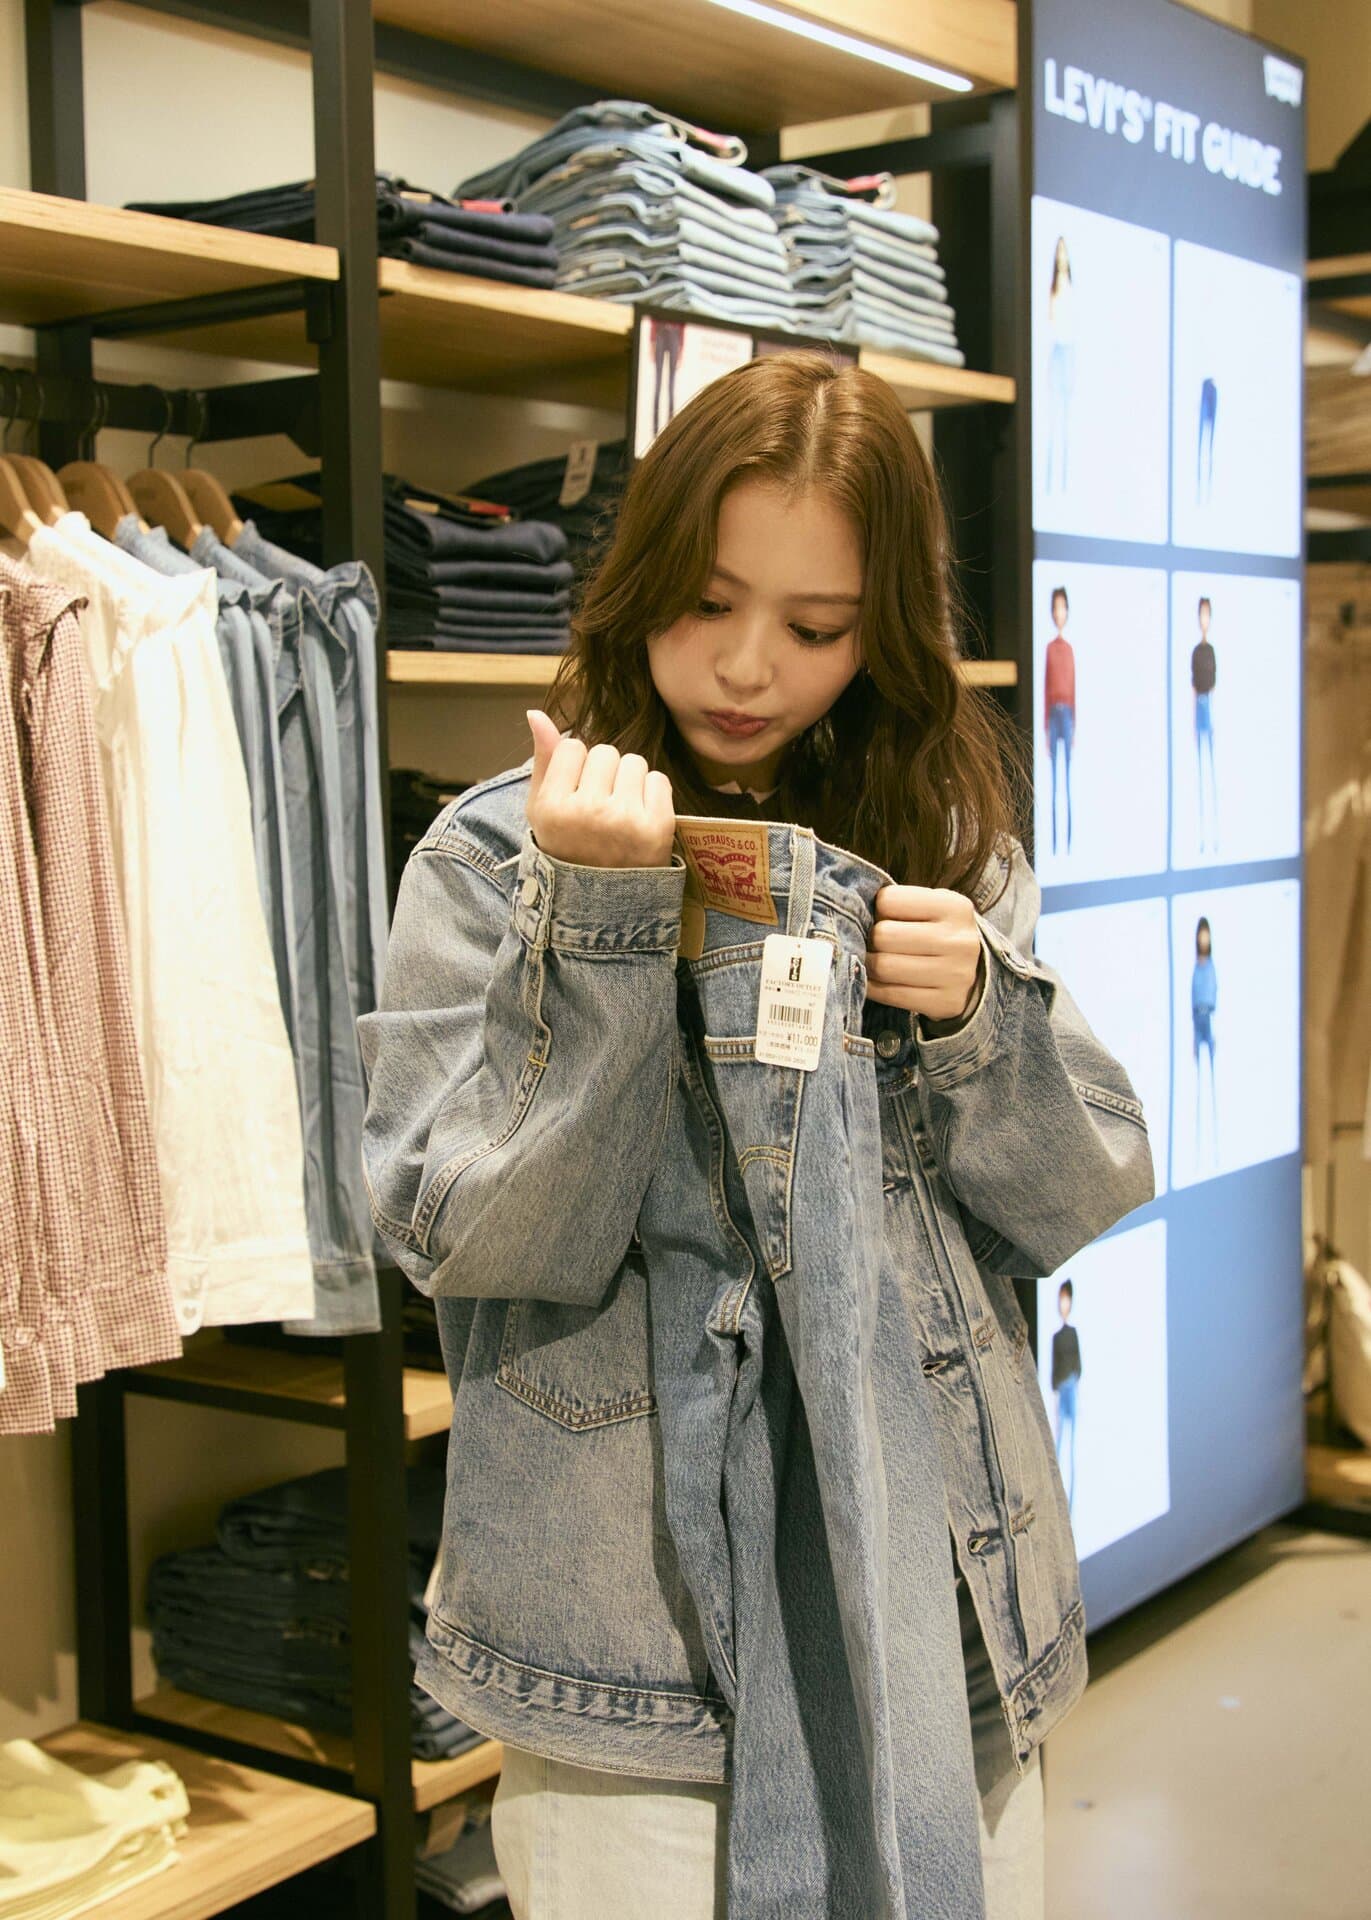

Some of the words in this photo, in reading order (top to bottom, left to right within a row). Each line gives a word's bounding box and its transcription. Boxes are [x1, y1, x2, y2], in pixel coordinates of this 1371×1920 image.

[1155, 101, 1200, 164] FIT
[1203, 123, 1282, 196] GUIDE
[687, 835, 701, 846] LEVI
[703, 834, 736, 849] STRAUSS
[737, 840, 743, 850] &
